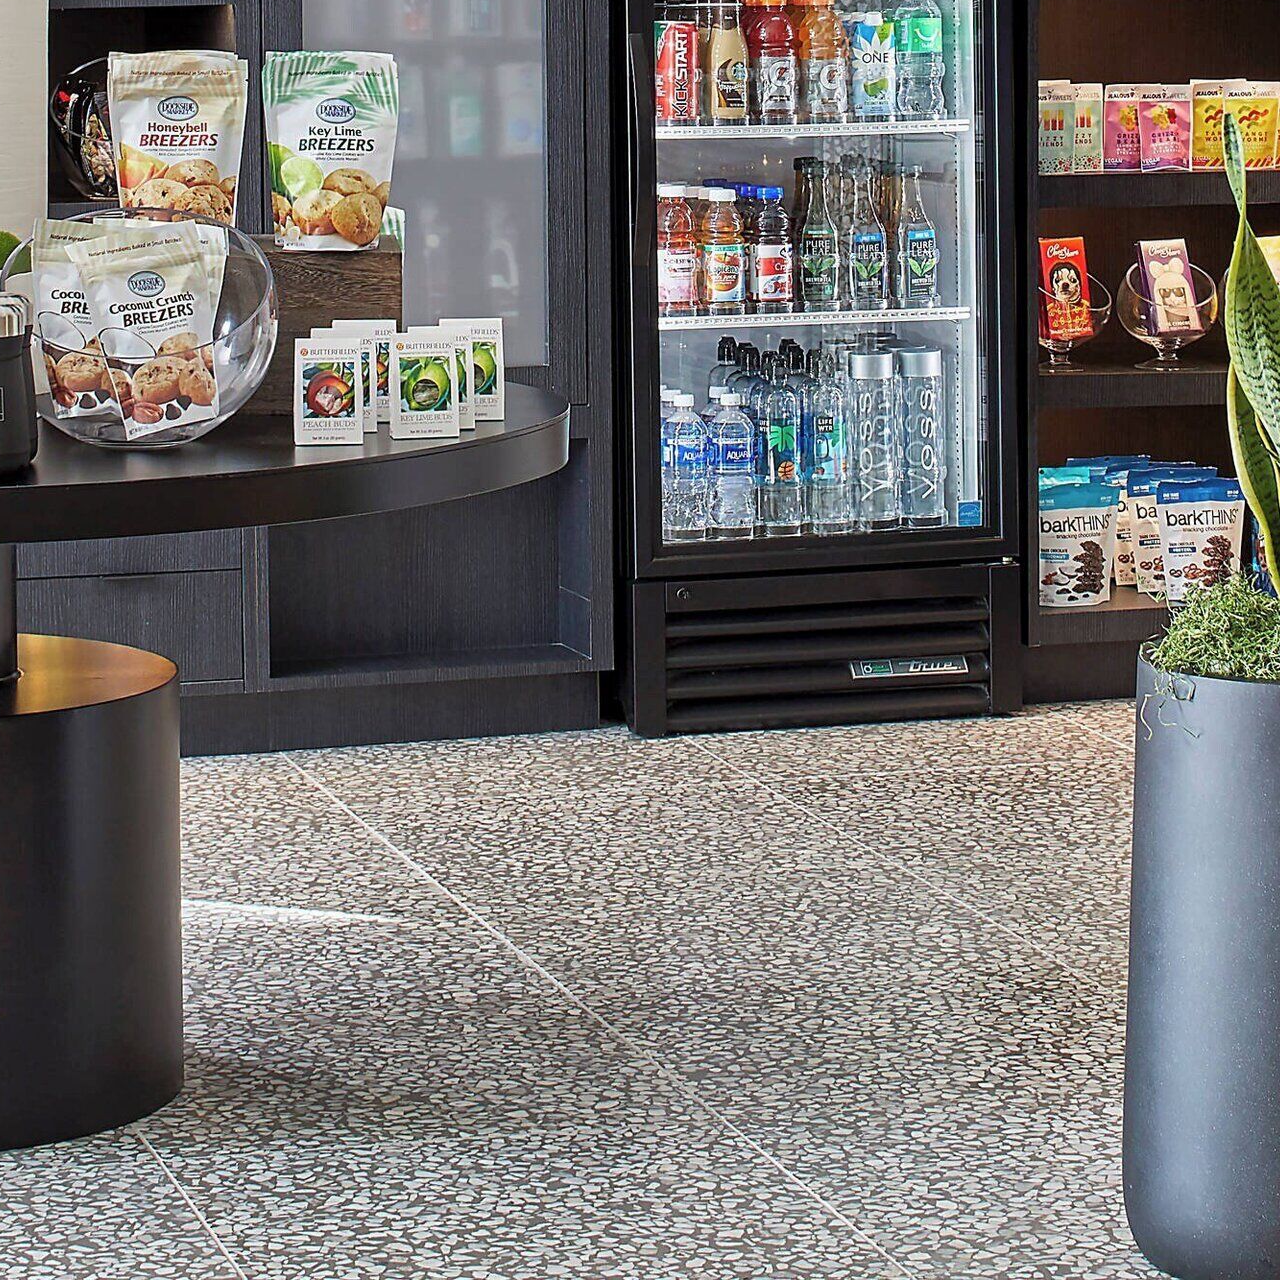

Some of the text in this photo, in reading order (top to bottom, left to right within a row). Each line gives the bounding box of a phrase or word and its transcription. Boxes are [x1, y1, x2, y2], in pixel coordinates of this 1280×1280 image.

[862, 53, 888, 63] ONE
[672, 31, 687, 118] KICKSTART
[148, 122, 207, 134] Honeybell
[309, 126, 362, 137] Key Lime
[139, 134, 218, 146] BREEZERS
[299, 139, 374, 151] BREEZERS
[806, 240, 830, 248] PURE
[858, 244, 879, 252] PURE
[912, 241, 934, 249] PURE
[109, 291, 194, 314] Coconut Crunch
[123, 303, 194, 328] BREEZERS
[303, 420, 331, 428] PEACH
[859, 391, 874, 502] VOSS
[920, 386, 935, 499] VOSS
[1040, 513, 1111, 533] barkTHINS
[1165, 509, 1238, 526] barkTHINS
[899, 661, 961, 671] true
